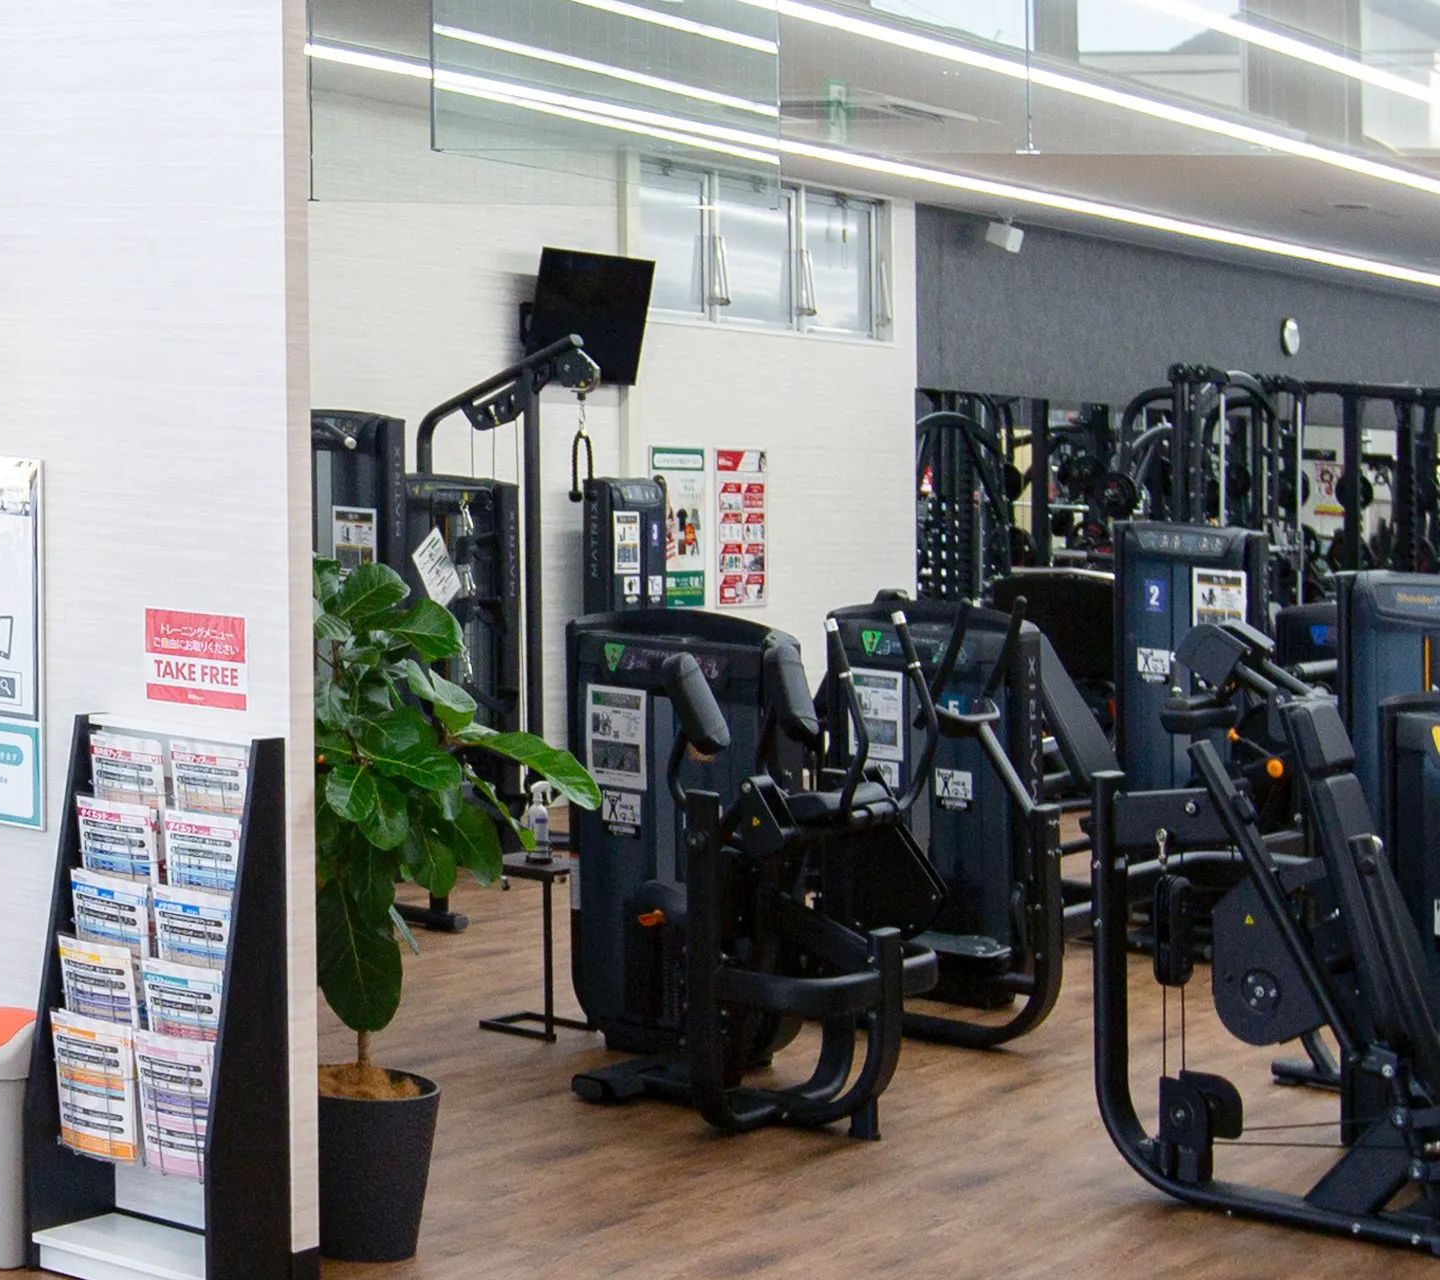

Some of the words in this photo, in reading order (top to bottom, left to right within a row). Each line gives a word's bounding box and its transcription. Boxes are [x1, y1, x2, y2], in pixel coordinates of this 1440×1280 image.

[590, 503, 598, 577] MATRIX
[1149, 585, 1160, 606] 2
[161, 623, 234, 640] トレーニングメニュー
[152, 636, 239, 656] ご自由にお取りください
[153, 658, 197, 682] TAKE
[200, 664, 239, 687] FREE
[1028, 656, 1037, 806] MATRIX
